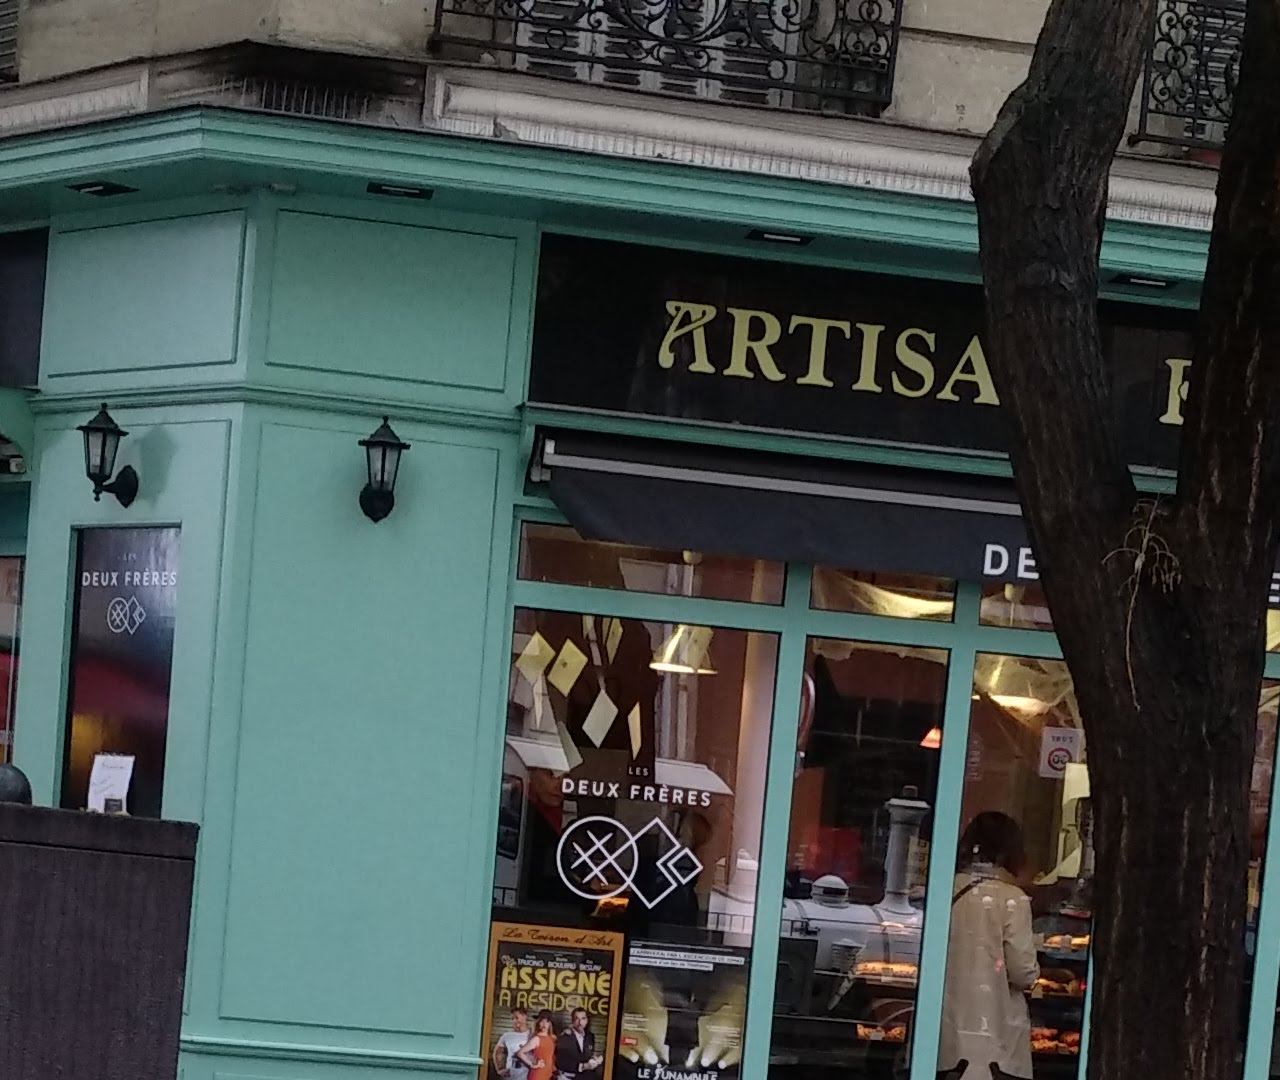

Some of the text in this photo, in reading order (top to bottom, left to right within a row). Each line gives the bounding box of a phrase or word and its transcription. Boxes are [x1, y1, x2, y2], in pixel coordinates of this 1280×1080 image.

[658, 299, 1001, 406] ARTISA
[982, 543, 1041, 580] DE
[82, 568, 177, 587] DEUX FRÈRES
[628, 766, 649, 777] LES
[561, 778, 711, 807] DEUX FRÈRES
[638, 1068, 650, 1078] LE
